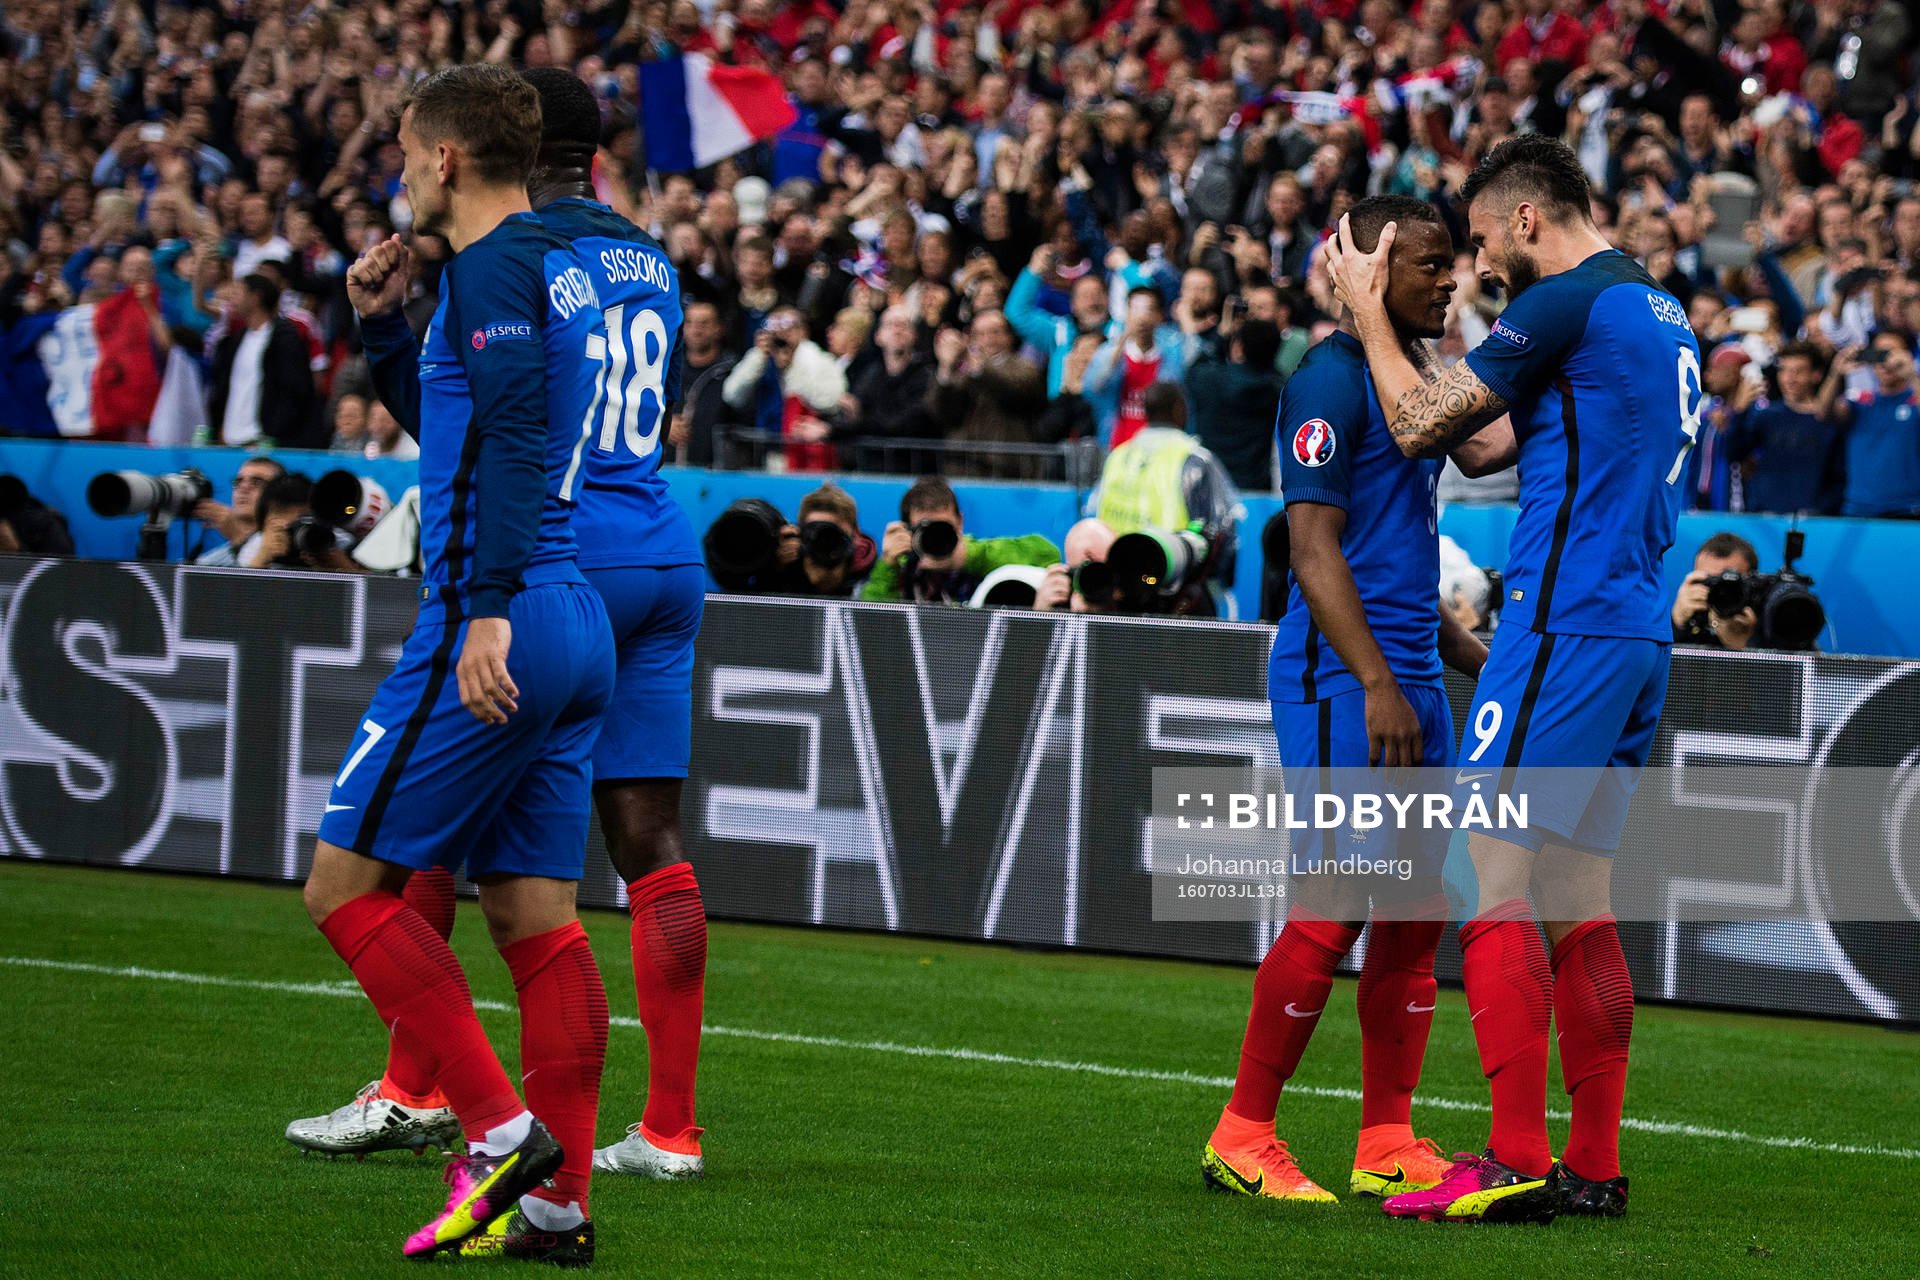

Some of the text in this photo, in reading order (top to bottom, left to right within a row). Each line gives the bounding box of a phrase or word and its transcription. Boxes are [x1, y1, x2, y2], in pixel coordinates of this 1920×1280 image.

[600, 248, 670, 293] SISSOKO
[485, 325, 532, 340] RESPECT
[1497, 324, 1529, 345] RESPECT
[598, 304, 668, 459] 18
[559, 333, 607, 501] 7
[1665, 346, 1702, 486] 9
[1427, 473, 1437, 536] 3
[335, 718, 387, 788] 7
[1468, 700, 1503, 762] 9
